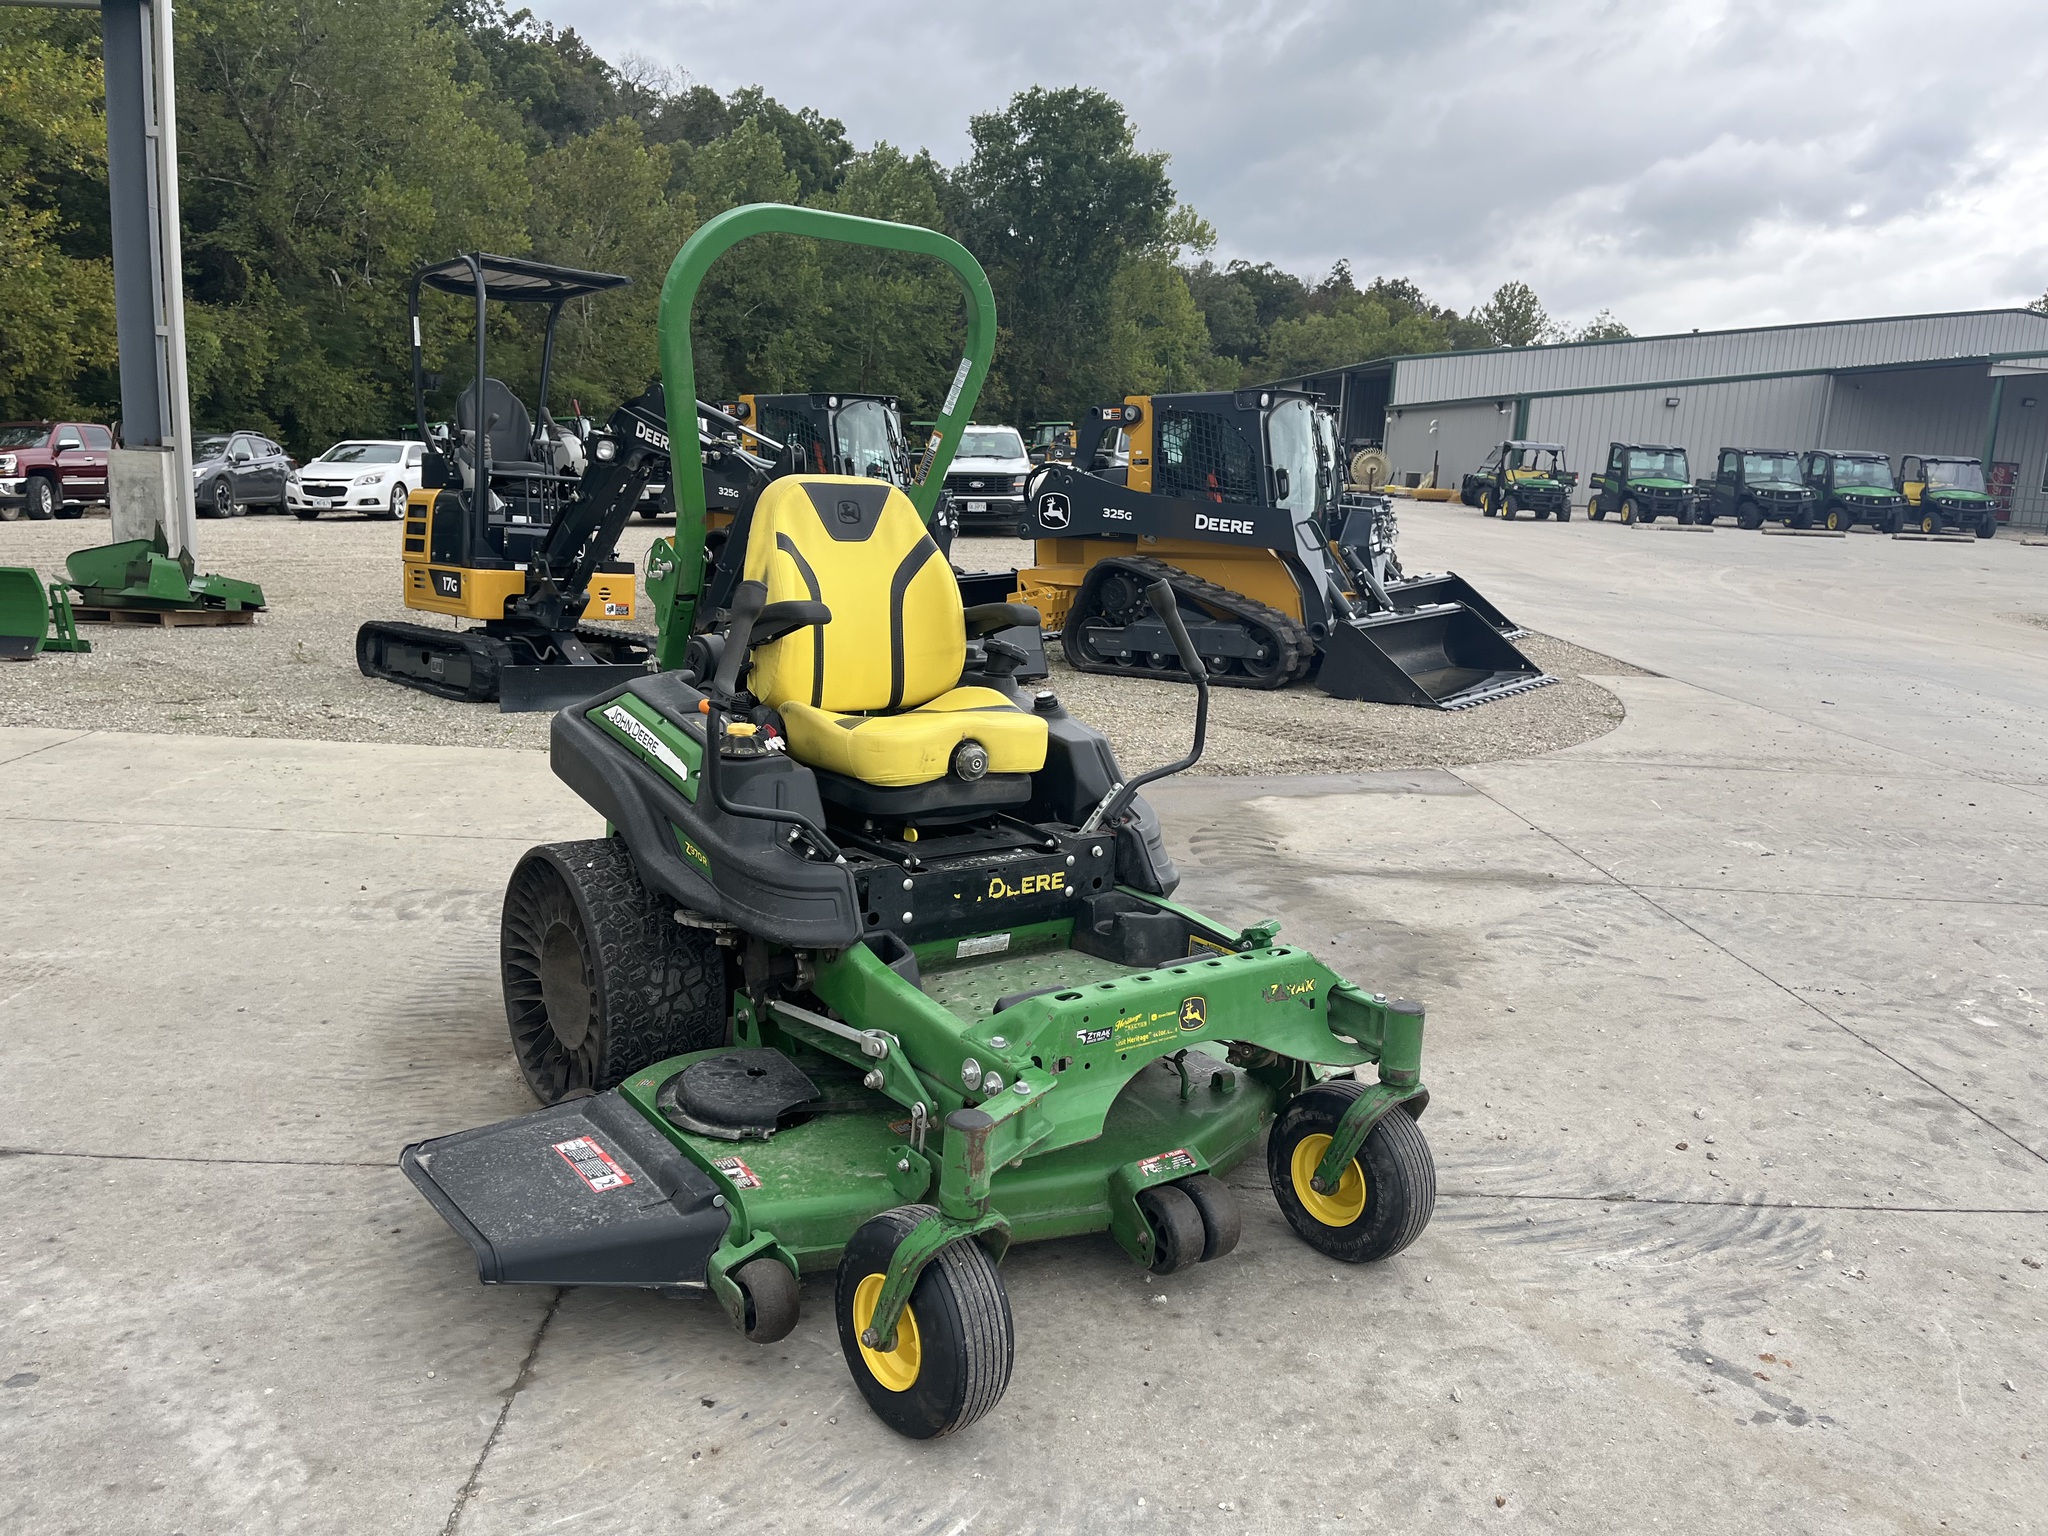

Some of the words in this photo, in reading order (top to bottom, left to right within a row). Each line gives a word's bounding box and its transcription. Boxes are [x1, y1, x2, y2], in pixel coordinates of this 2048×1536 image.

[636, 421, 671, 452] DEER
[718, 486, 739, 498] 325G
[1102, 507, 1133, 521] 325G
[1194, 513, 1254, 535] DEERE
[442, 576, 458, 593] 17G
[610, 708, 634, 736] JOHN
[631, 722, 660, 754] DEERE
[1087, 1029, 1112, 1041] ZTRAK
